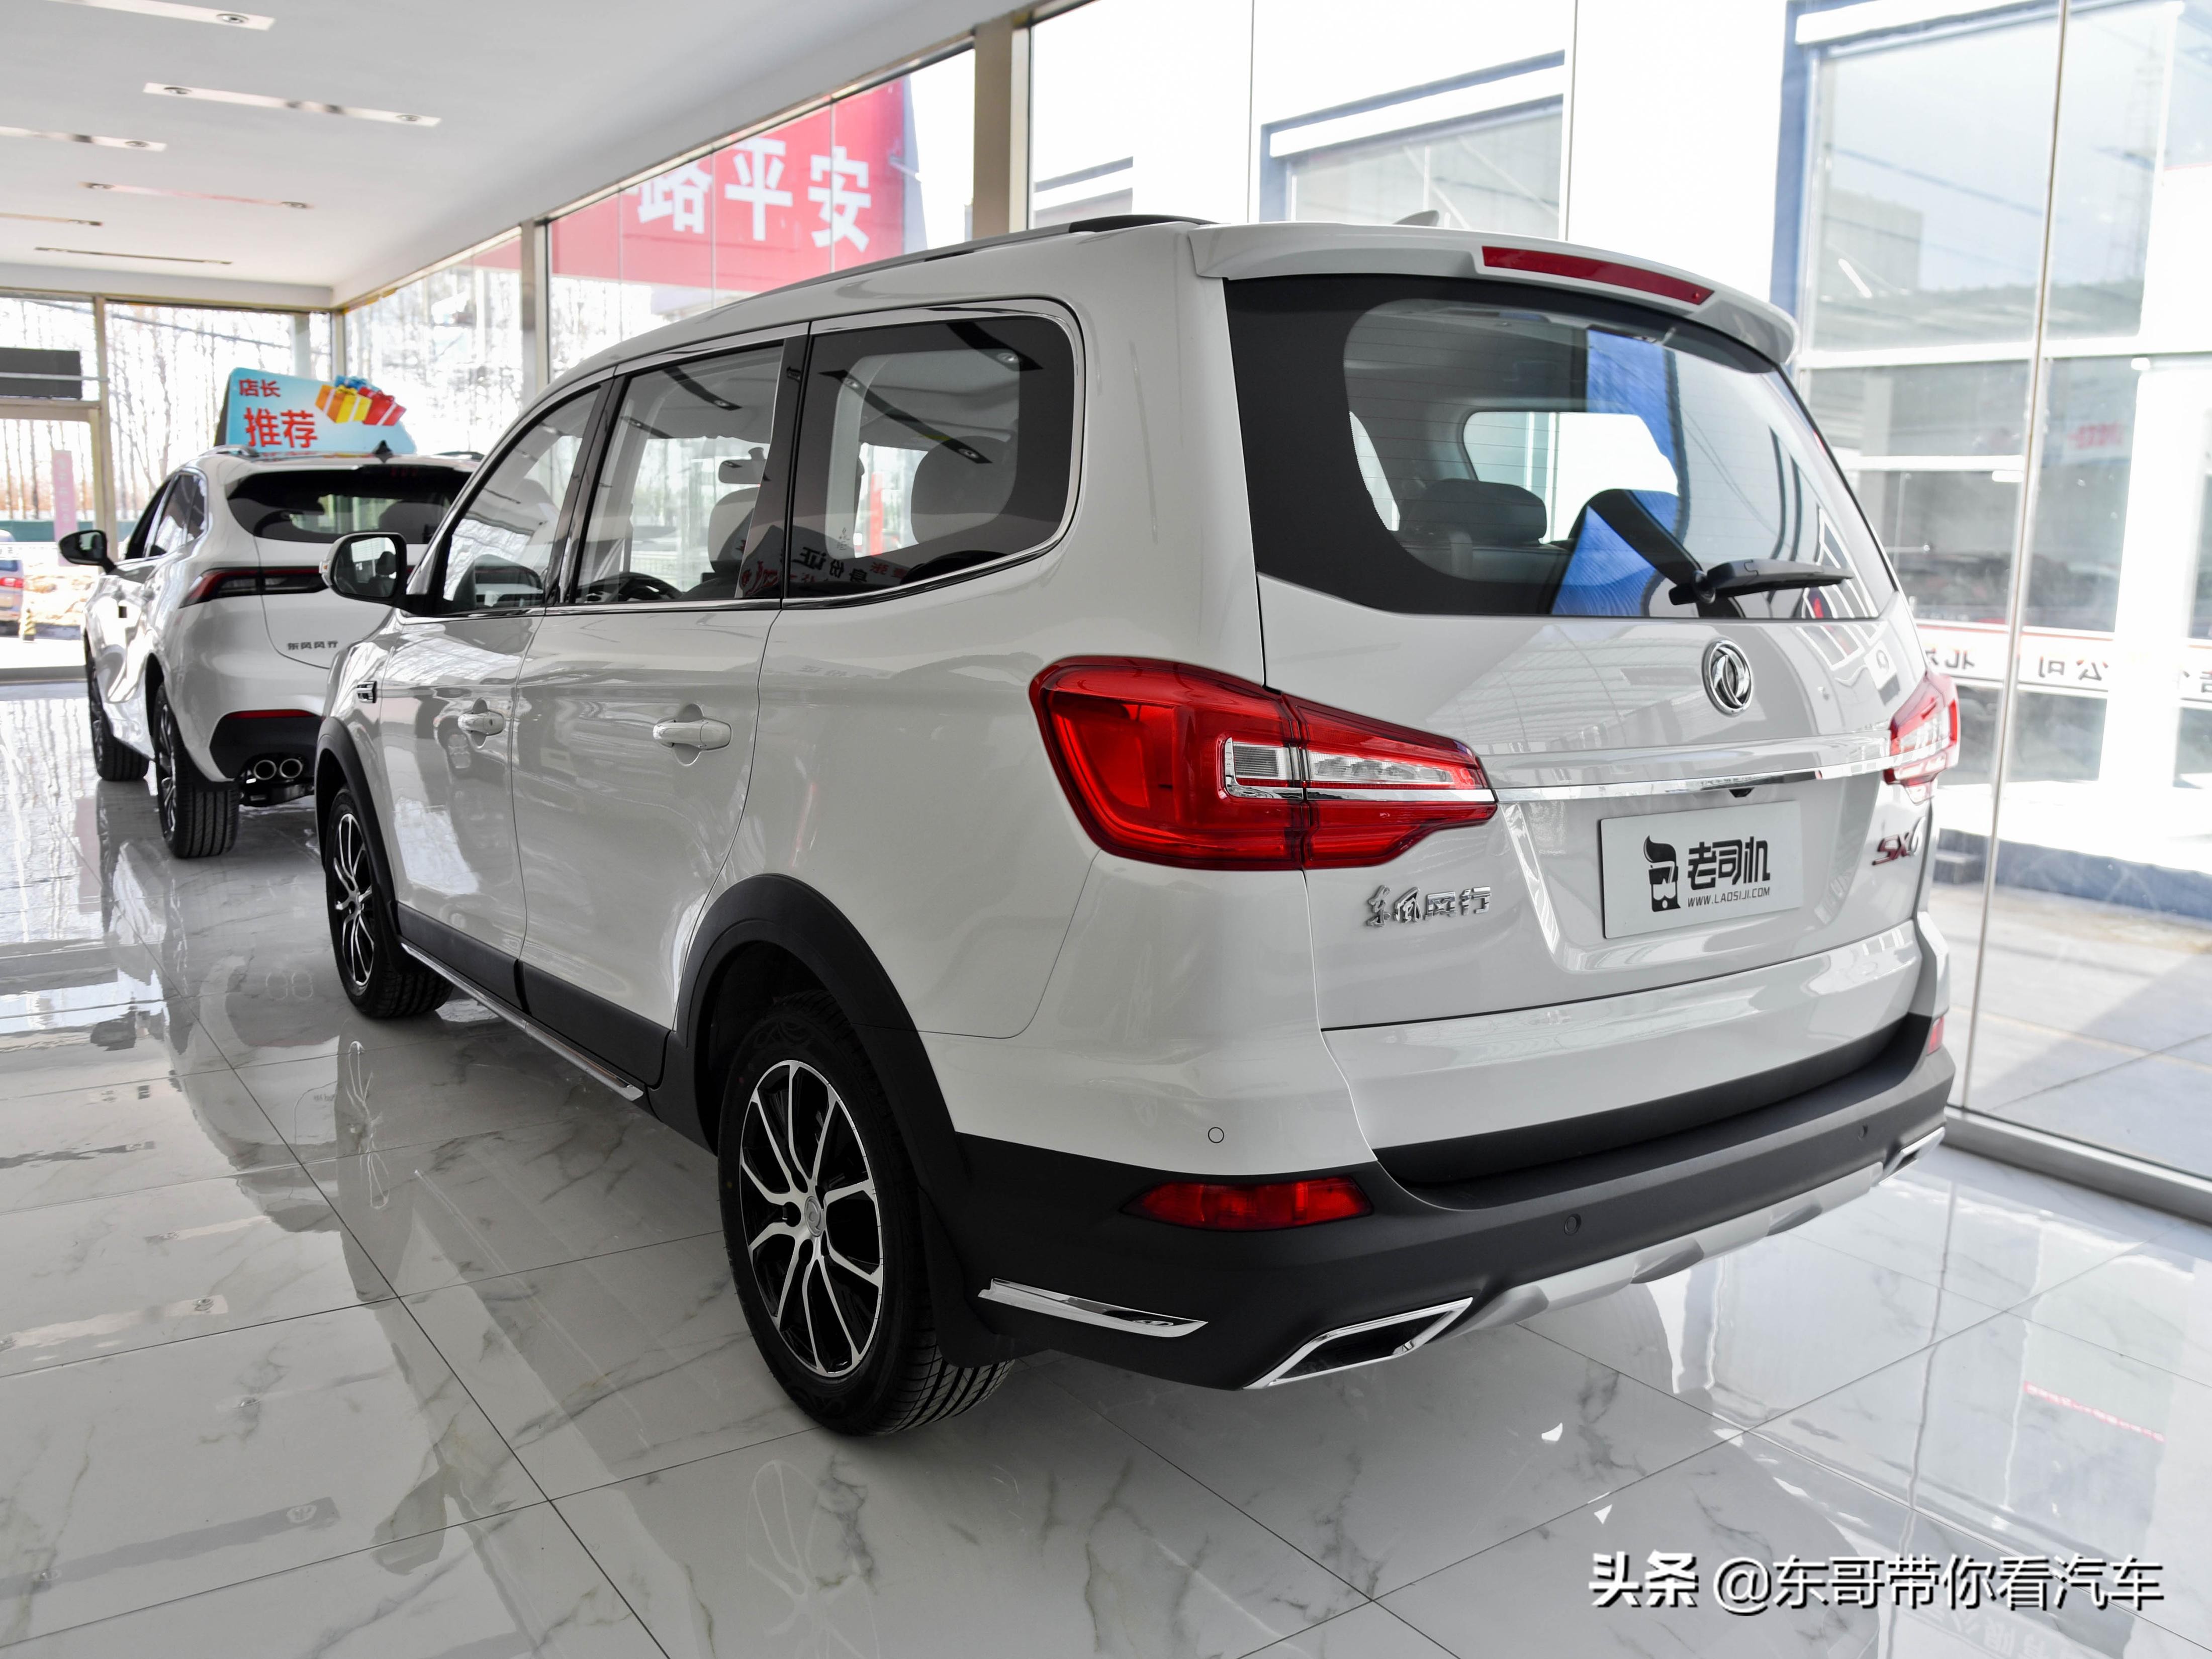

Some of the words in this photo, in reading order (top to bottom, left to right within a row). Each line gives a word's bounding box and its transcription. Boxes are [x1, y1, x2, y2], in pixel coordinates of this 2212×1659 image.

[623, 137, 872, 252] 路平安
[238, 378, 281, 398] 店长
[244, 407, 319, 449] 推荐
[287, 640, 338, 651] 东风风行
[1871, 815, 1927, 866] SX6
[1688, 836, 1771, 890] 老司机
[1366, 884, 1493, 927] 东风风行
[1688, 886, 1770, 907] WWW.LAOSIJI.COM
